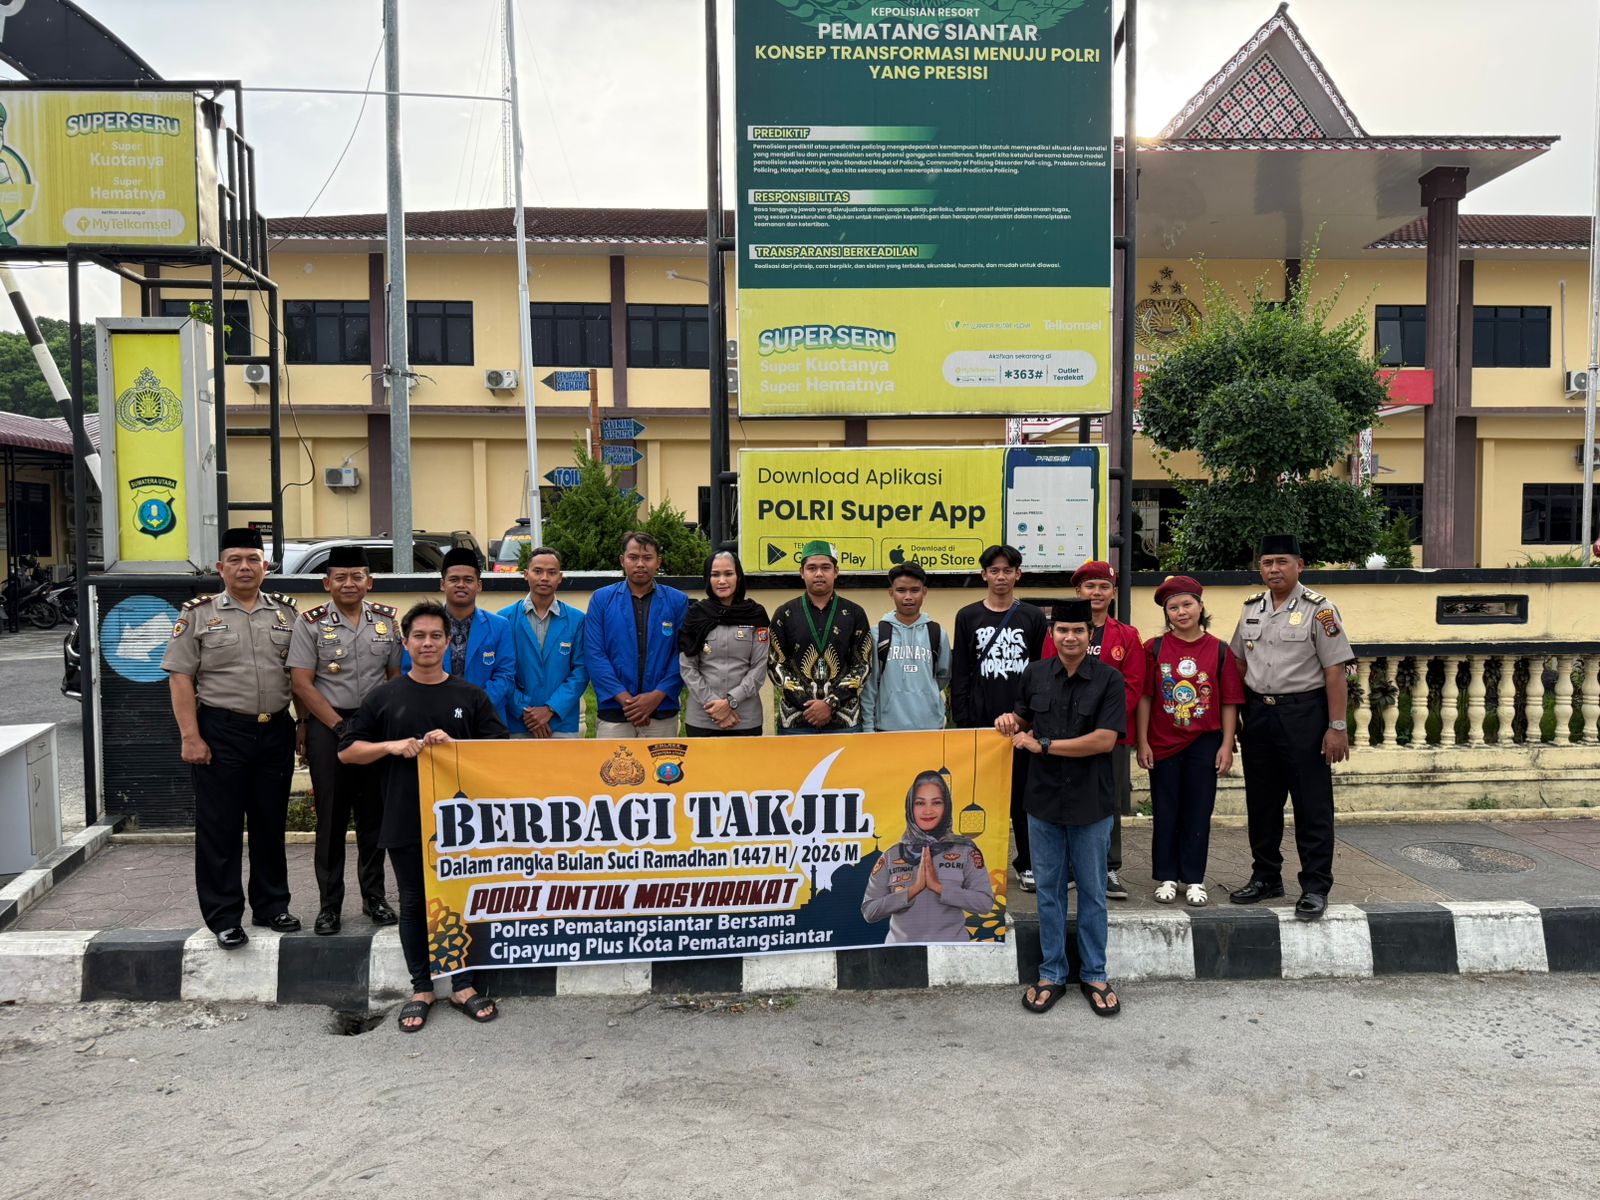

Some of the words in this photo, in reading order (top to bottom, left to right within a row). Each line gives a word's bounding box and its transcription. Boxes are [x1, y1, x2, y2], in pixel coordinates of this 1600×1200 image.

[871, 7, 936, 17] KEPOLISIAN
[938, 8, 980, 18] RESORT
[818, 23, 940, 41] PEMATANG
[944, 23, 1038, 42] SIANTAR
[755, 44, 826, 60] KONSEP
[830, 45, 969, 62] TRANSFORMASI
[973, 46, 1047, 62] MENUJU
[1051, 48, 1100, 63] POLRI
[869, 65, 921, 80] YANG
[924, 65, 988, 80] PRESISI
[66, 112, 128, 136] SUPER
[130, 112, 180, 136] SERU
[753, 128, 810, 139] PREDIKTIF
[111, 141, 142, 152] Super
[90, 152, 164, 168] Kuotanya
[113, 176, 143, 187] Super
[90, 187, 166, 202] Hematnya
[754, 191, 850, 202] RESPONSIBILITAS
[92, 218, 171, 232] MyTelkomsel
[755, 246, 842, 258] TRANSPARANSI
[843, 246, 918, 258] BERKEADILAN
[1043, 320, 1103, 331] Telkomsel
[760, 326, 834, 356] SUPER
[836, 326, 896, 354] SERU
[1015, 353, 1045, 361] sekarang
[760, 360, 802, 374] Super
[806, 357, 889, 375] Kuotanya
[760, 380, 802, 394] Super
[806, 377, 895, 395] Hematnya
[130, 478, 157, 488] SUMATERA
[158, 478, 176, 488] UTARA
[758, 467, 859, 484] Download
[866, 468, 943, 490] Aplikasi
[758, 499, 834, 520] POLRI
[841, 500, 923, 529] Super
[929, 501, 986, 530] App
[841, 552, 866, 567] Play
[912, 553, 938, 567] App
[940, 553, 975, 566] Store
[976, 626, 1026, 652] BRNG
[438, 797, 672, 848] BERBAGI
[688, 792, 870, 840] TAKJIL
[440, 856, 493, 878] Dalam
[496, 853, 552, 876] rangka
[557, 852, 604, 872] Bulan
[607, 851, 640, 870] Suci
[643, 848, 727, 870] Ramadhan
[733, 846, 770, 866] 1447
[801, 844, 841, 863] 2026
[844, 844, 858, 862] M
[938, 862, 964, 870] POLRI
[469, 885, 543, 916] POLRI
[546, 884, 630, 912] UNTUK
[633, 878, 798, 910] MASYARAKAT
[490, 920, 549, 939] Polres
[554, 916, 712, 938] Pematangsiantar
[718, 914, 796, 931] Bersama
[490, 940, 580, 964] Cipayung
[586, 938, 624, 955] Plus
[628, 936, 673, 953] Kota
[678, 928, 833, 952] Pematangsiantar
